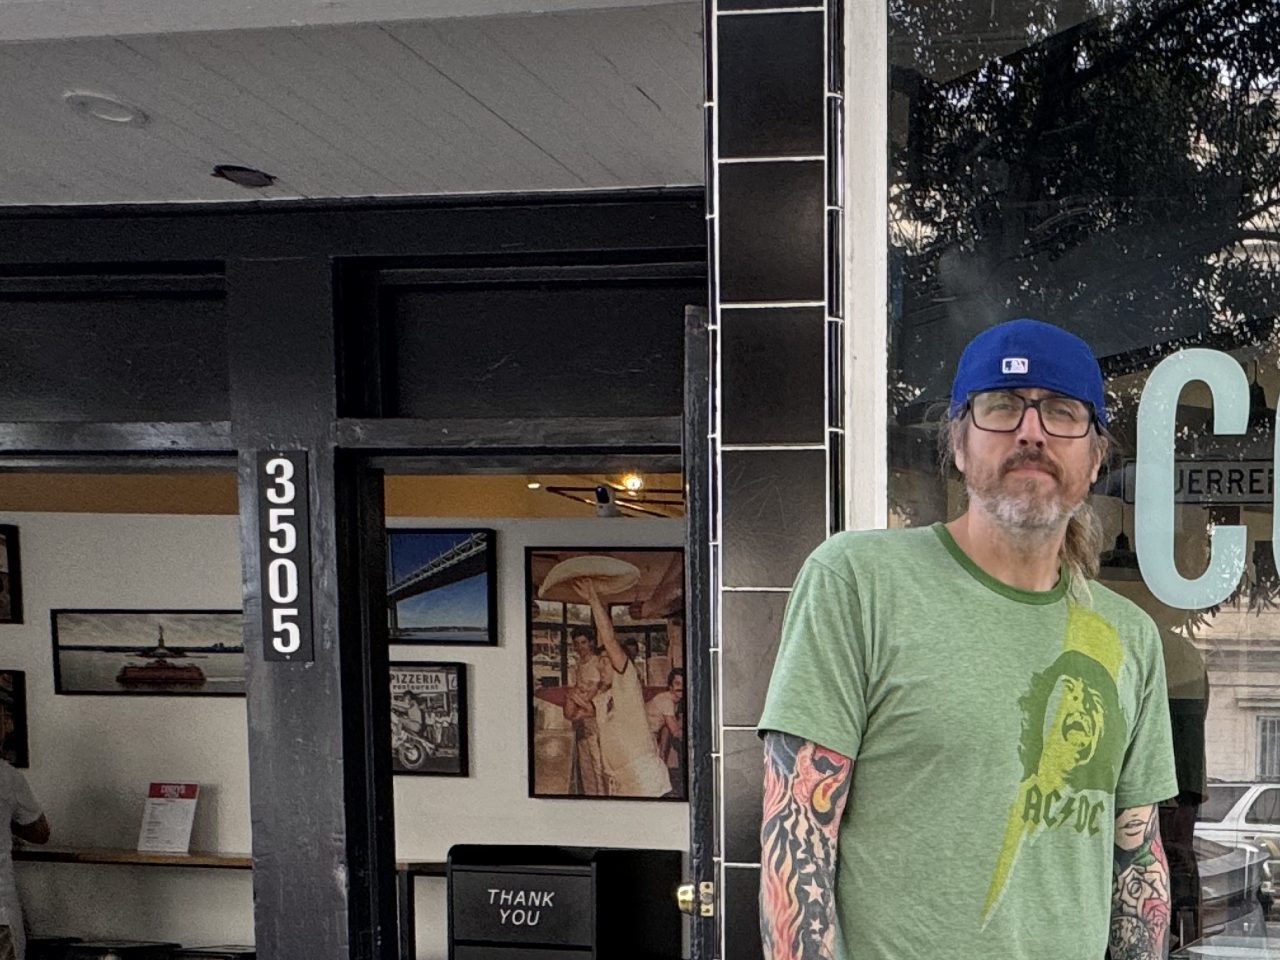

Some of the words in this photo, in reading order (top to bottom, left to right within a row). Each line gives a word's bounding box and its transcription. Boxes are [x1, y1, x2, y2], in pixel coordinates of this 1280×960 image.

[265, 457, 301, 654] 3505
[488, 889, 555, 907] THANK
[500, 909, 540, 926] YOU
